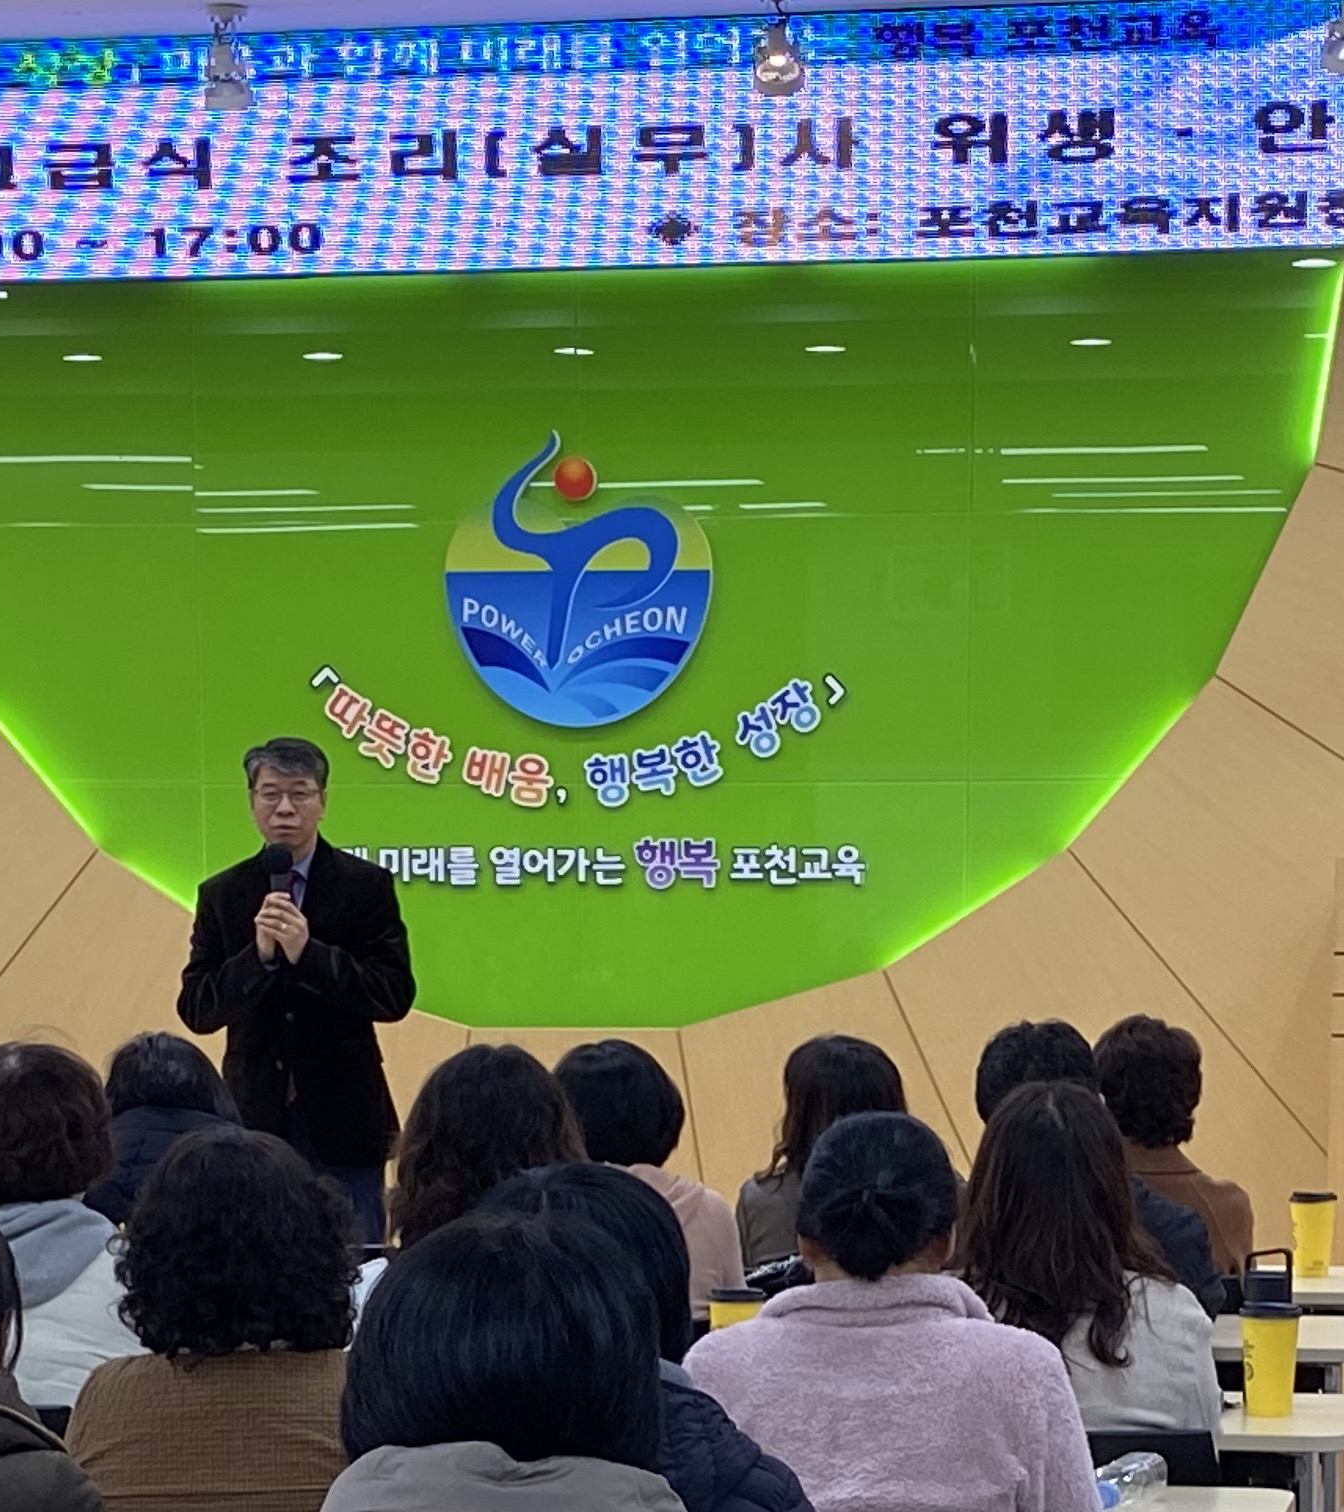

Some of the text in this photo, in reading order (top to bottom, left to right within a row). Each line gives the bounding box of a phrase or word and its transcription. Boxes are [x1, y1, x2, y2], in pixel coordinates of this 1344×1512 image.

[931, 107, 1121, 166] 위생
[149, 222, 323, 260] 17:00
[737, 206, 880, 245] 장소:
[461, 598, 550, 669] POWER
[463, 747, 568, 808] 배움,
[584, 731, 724, 808] 행복한
[379, 837, 866, 889] 미래를 열어가는 행복 포천교육
